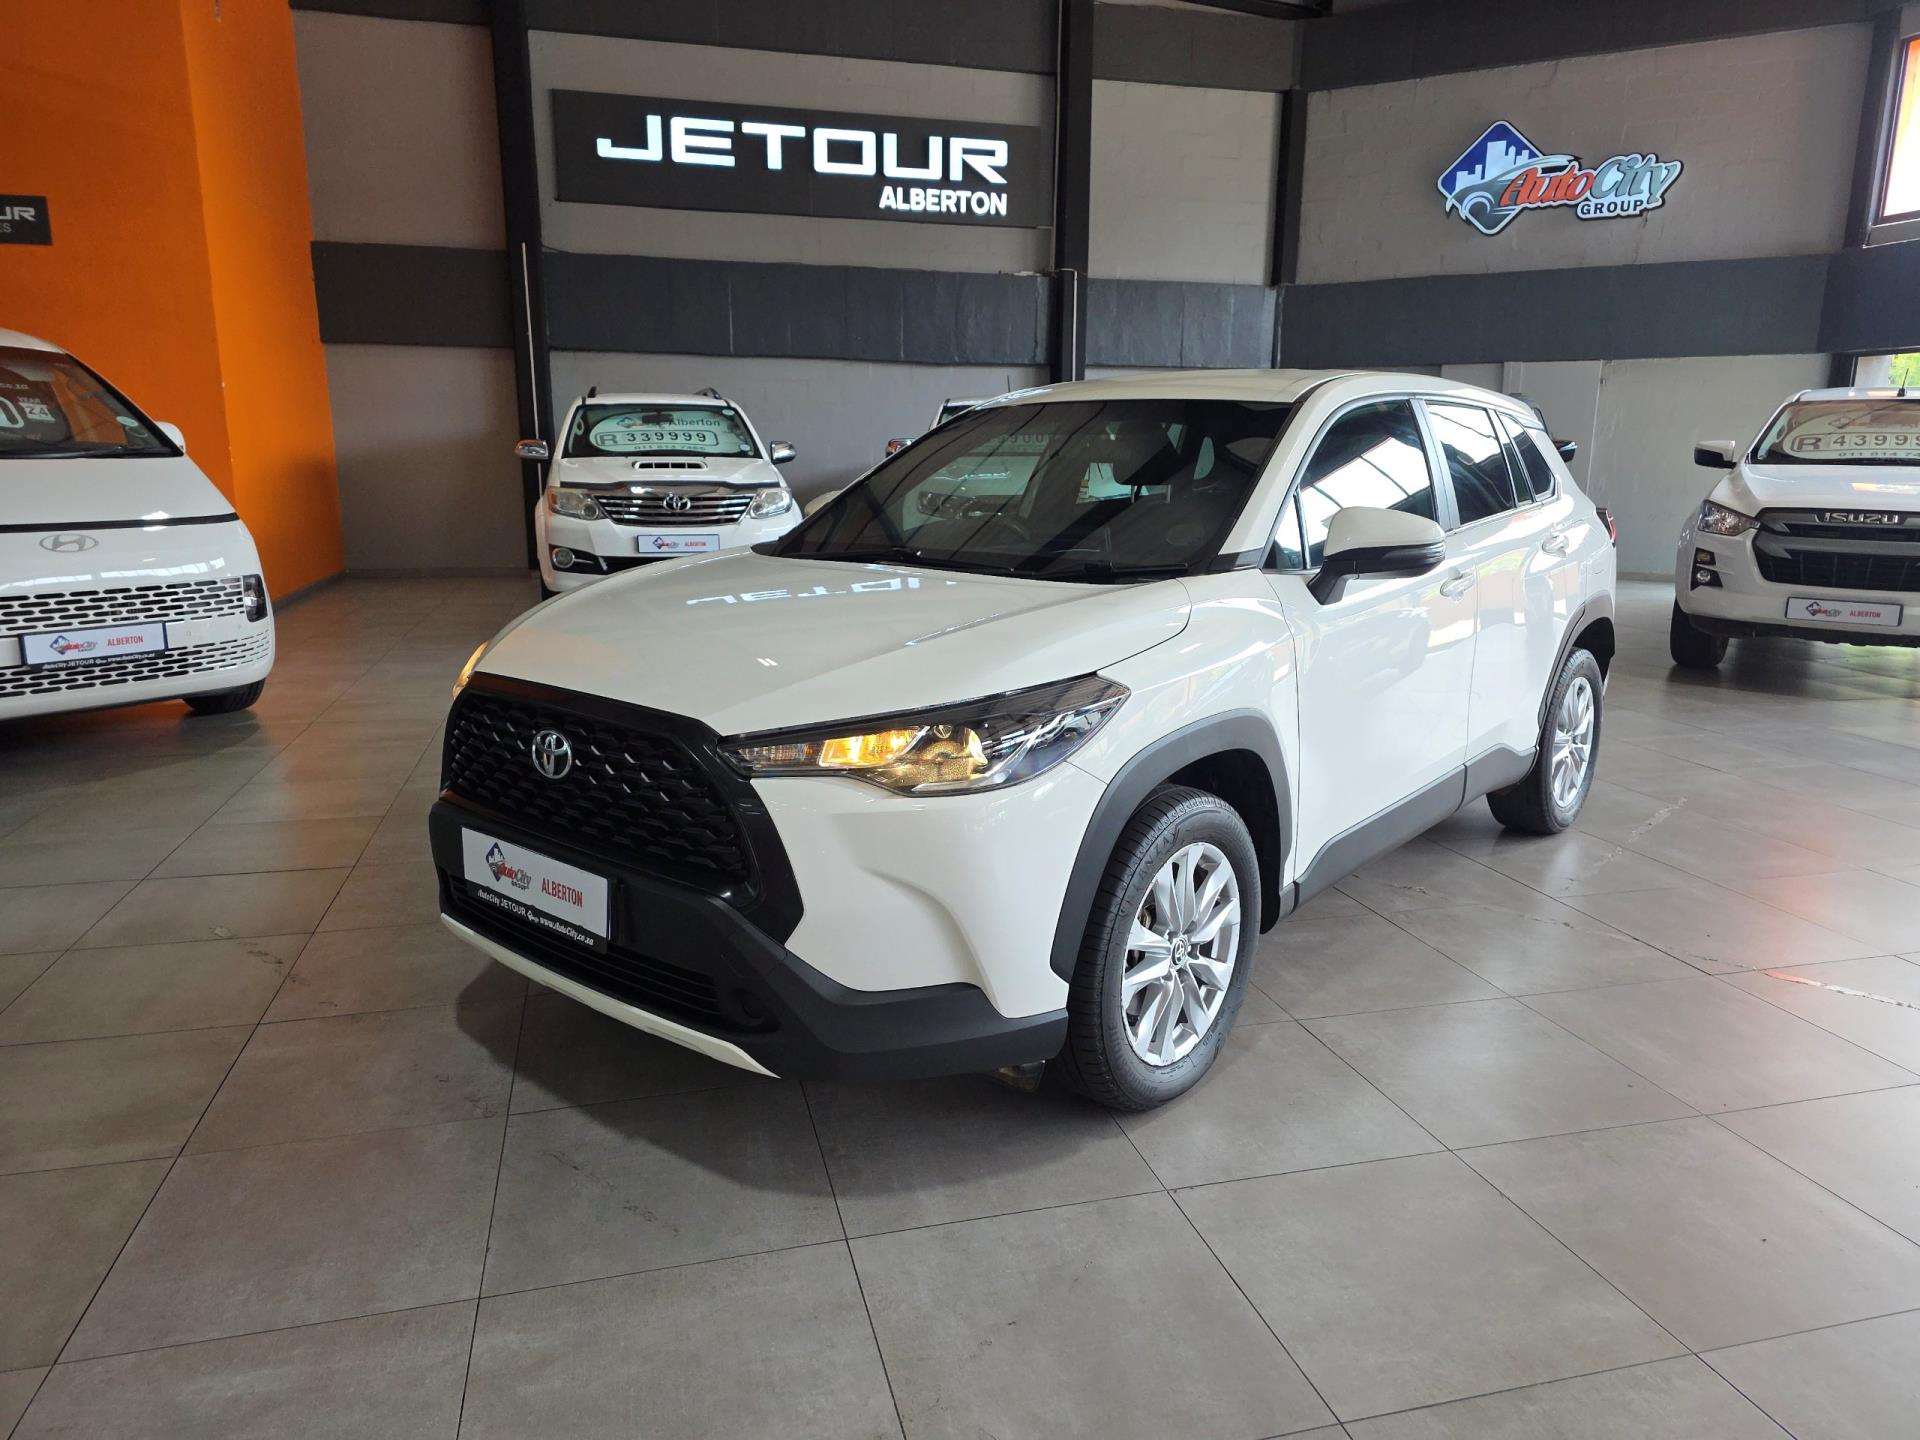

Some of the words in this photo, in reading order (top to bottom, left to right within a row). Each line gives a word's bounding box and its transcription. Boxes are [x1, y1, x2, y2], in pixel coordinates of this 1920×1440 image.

[596, 114, 1008, 184] JETOUR
[1500, 157, 1681, 206] AutoCity
[879, 185, 1008, 216] ALBERTON
[1581, 200, 1643, 215] GROUP
[600, 434, 618, 445] R
[626, 432, 707, 443] 339999
[1797, 437, 1822, 450] R
[1814, 512, 1899, 524] ISUZU
[1849, 609, 1882, 618] ALBERTON
[107, 635, 144, 647] ALBERTON
[67, 658, 95, 667] JETOUR
[498, 861, 532, 886] AutoCity
[541, 878, 583, 908] ALBERTON
[478, 889, 500, 907] AutoCity
[501, 898, 527, 918] JETOUR
[539, 917, 594, 946] www.AutoCity.co.za
